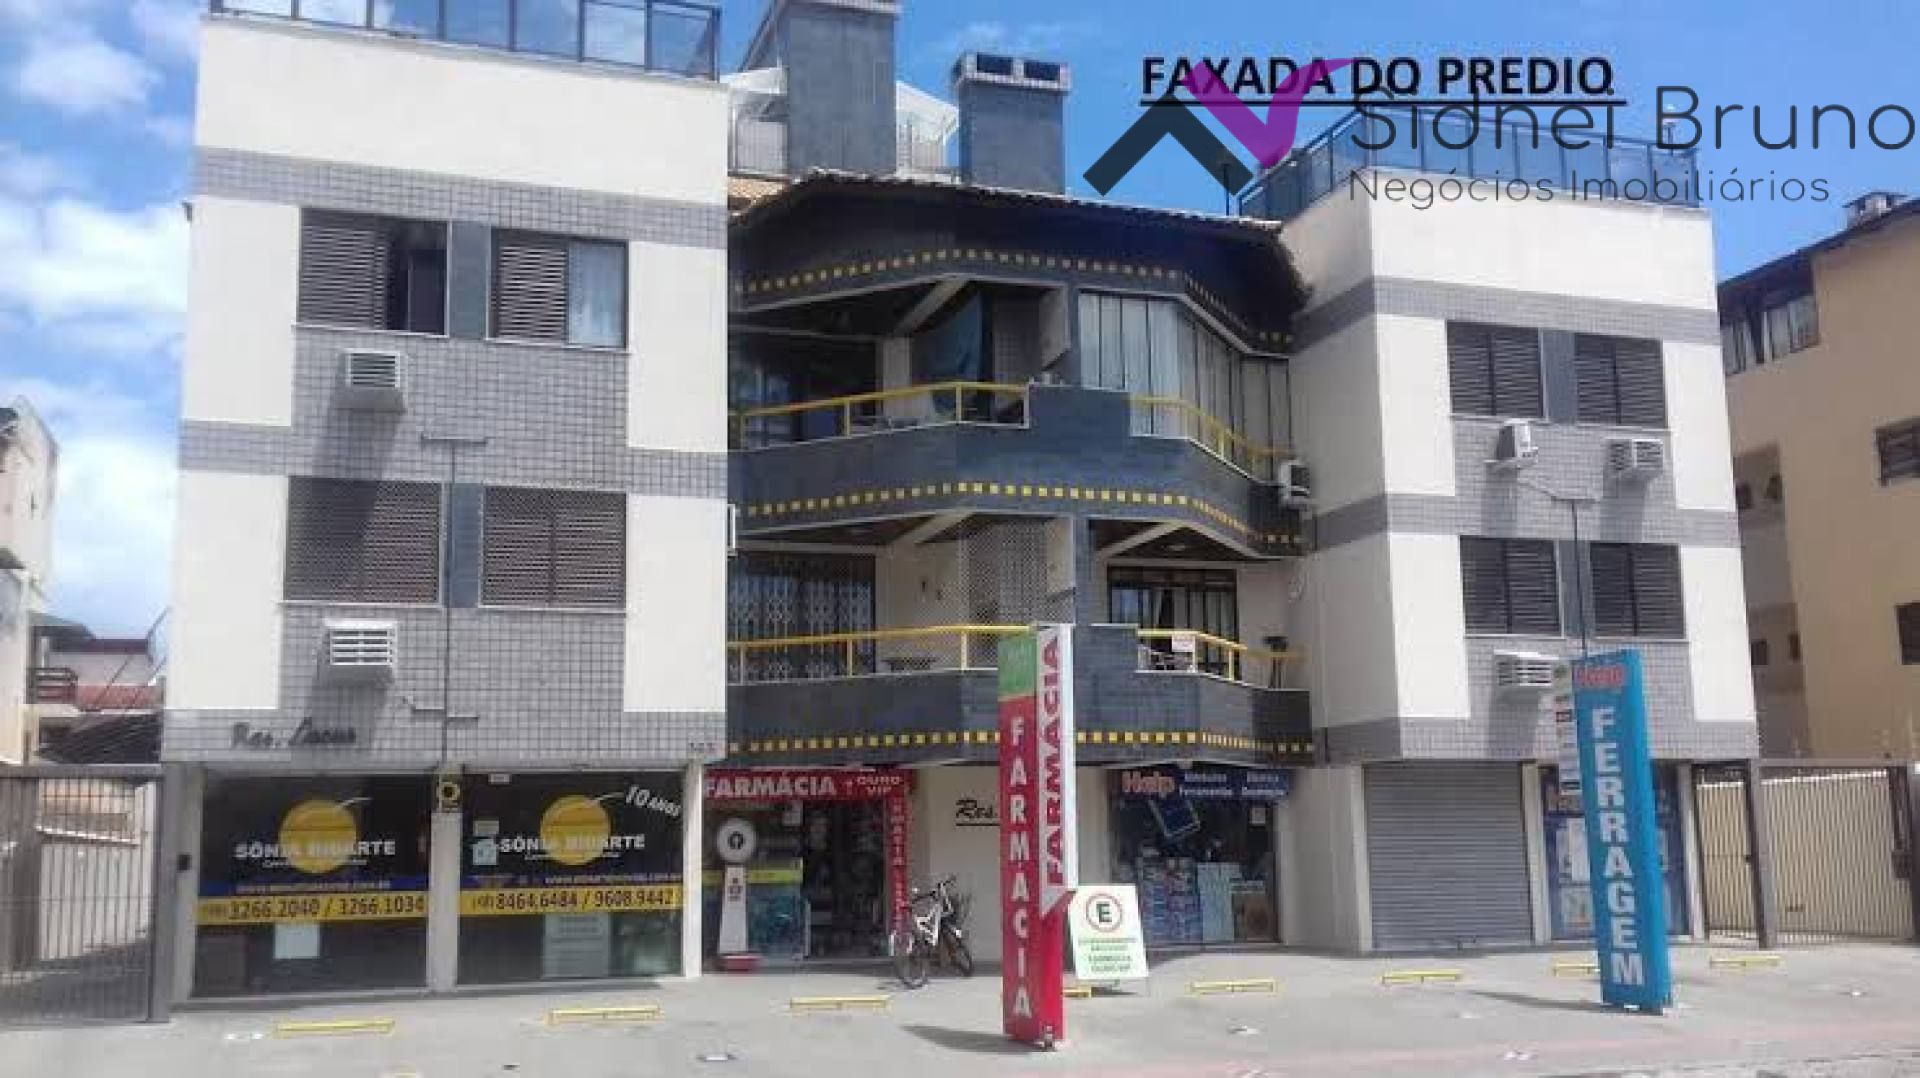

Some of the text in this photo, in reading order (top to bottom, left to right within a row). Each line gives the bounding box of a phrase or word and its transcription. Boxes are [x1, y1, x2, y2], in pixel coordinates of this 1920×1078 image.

[704, 772, 837, 797] FARMÁCIA
[1591, 708, 1645, 986] FERRAGEM
[1095, 902, 1113, 923] E
